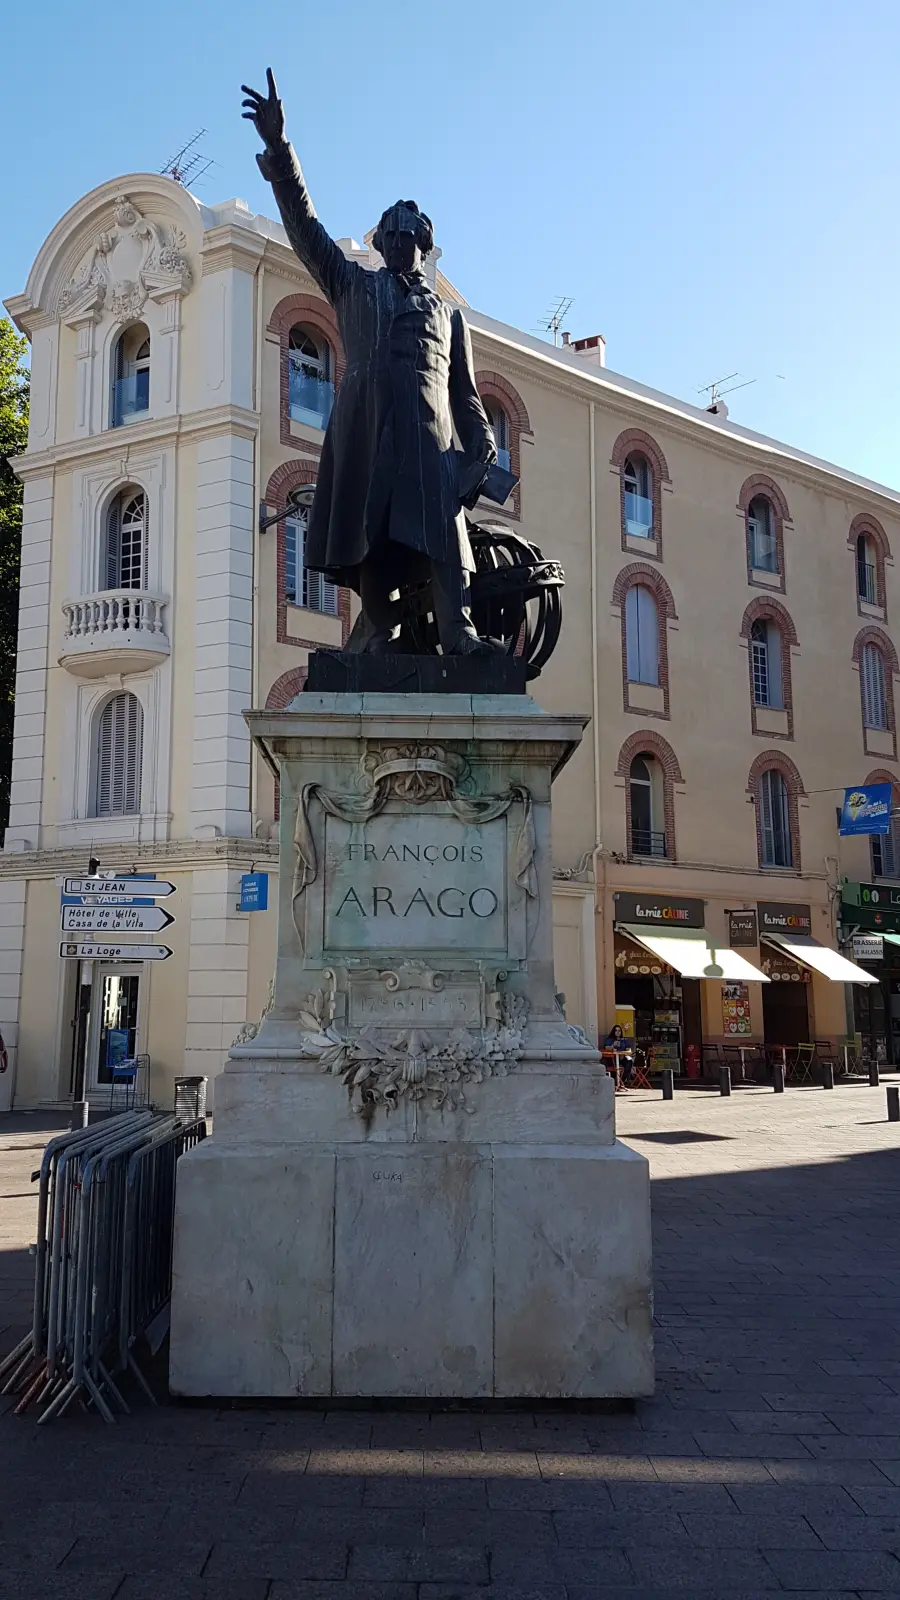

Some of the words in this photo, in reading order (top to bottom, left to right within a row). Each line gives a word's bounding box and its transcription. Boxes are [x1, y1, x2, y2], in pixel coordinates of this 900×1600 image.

[348, 843, 483, 866] FRANÇOIS
[84, 882, 96, 891] St
[98, 883, 126, 892] JEAN
[81, 897, 133, 905] VYAGES
[335, 886, 499, 919] ARAGO
[68, 909, 96, 918] Hôtel
[98, 909, 110, 918] de
[114, 909, 137, 919] Ville
[636, 904, 645, 917] la
[645, 906, 662, 918] mie
[68, 919, 92, 928] Casa
[96, 919, 108, 928] de
[111, 919, 121, 929] la
[126, 919, 144, 928] Vila
[764, 913, 773, 924] la
[772, 914, 787, 925] mie
[731, 920, 739, 929] la
[739, 920, 753, 929] mie
[81, 946, 93, 955] La
[96, 946, 121, 957] Loge
